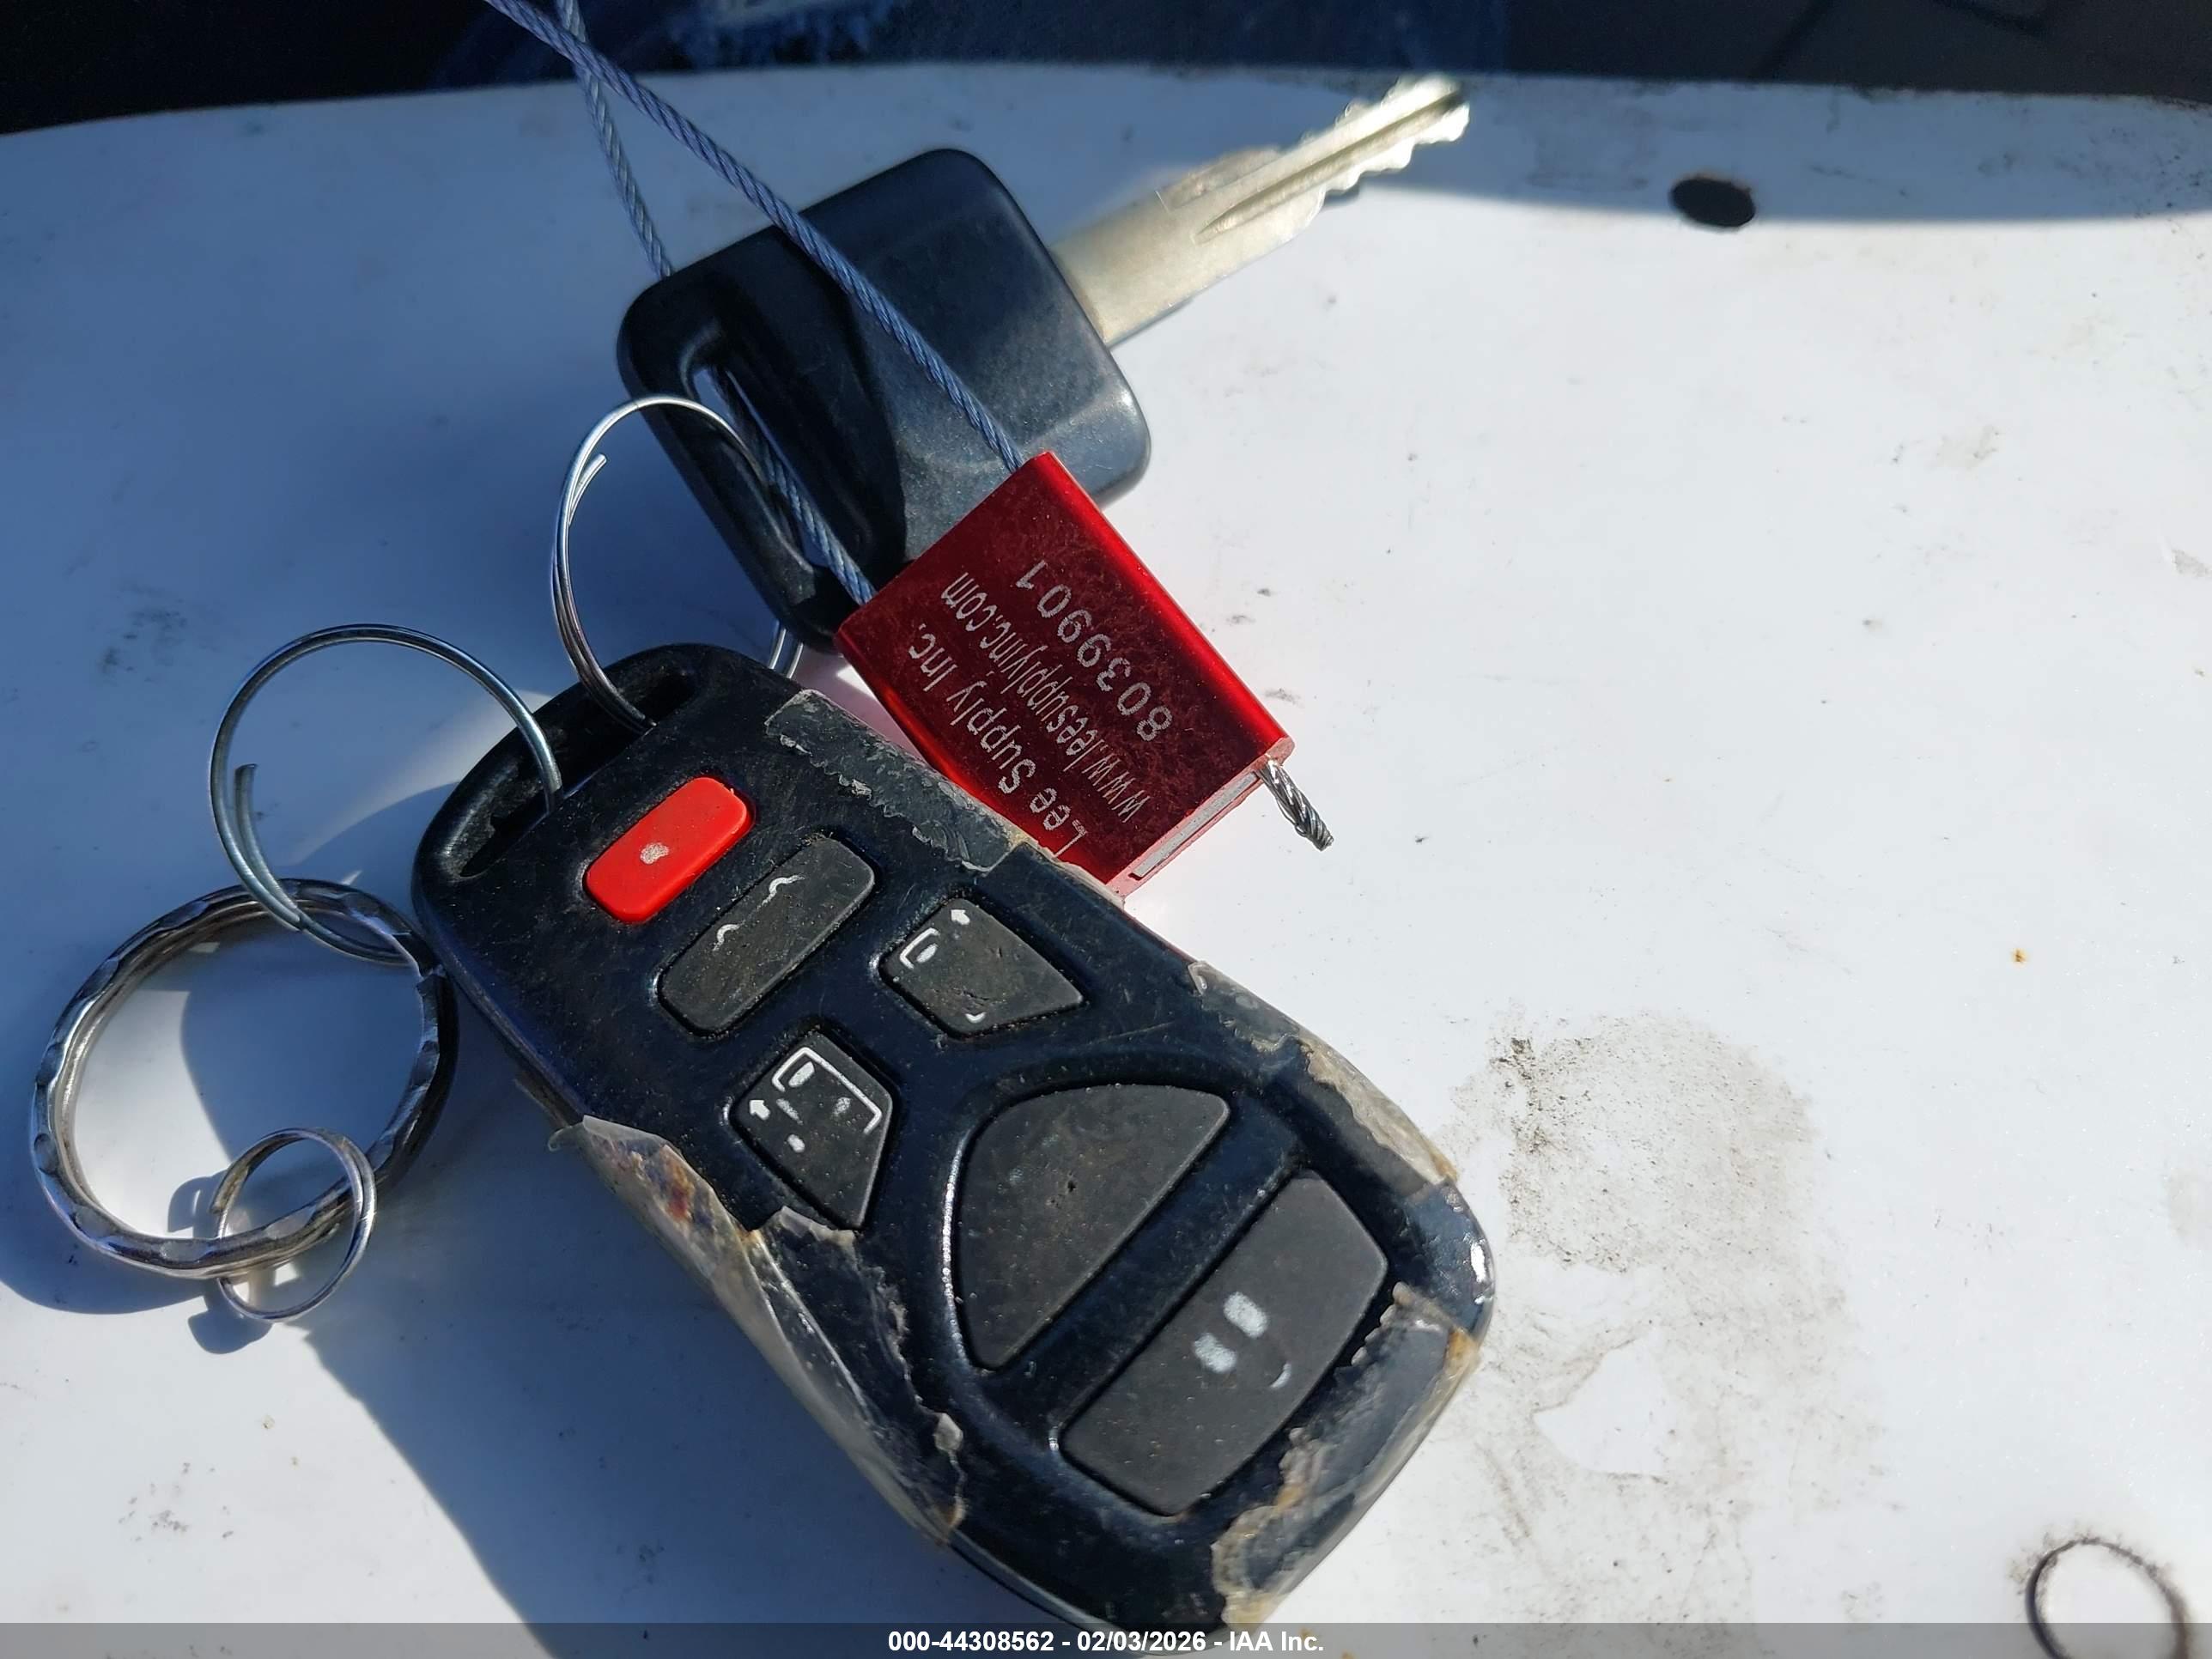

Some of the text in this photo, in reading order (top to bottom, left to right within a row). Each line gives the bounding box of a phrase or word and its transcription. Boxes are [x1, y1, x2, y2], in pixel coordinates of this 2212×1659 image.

[908, 623, 1088, 859] Lee Supply Inc.
[940, 572, 1151, 823] www.leesupplyinc.com
[1016, 560, 1173, 742] 8039901
